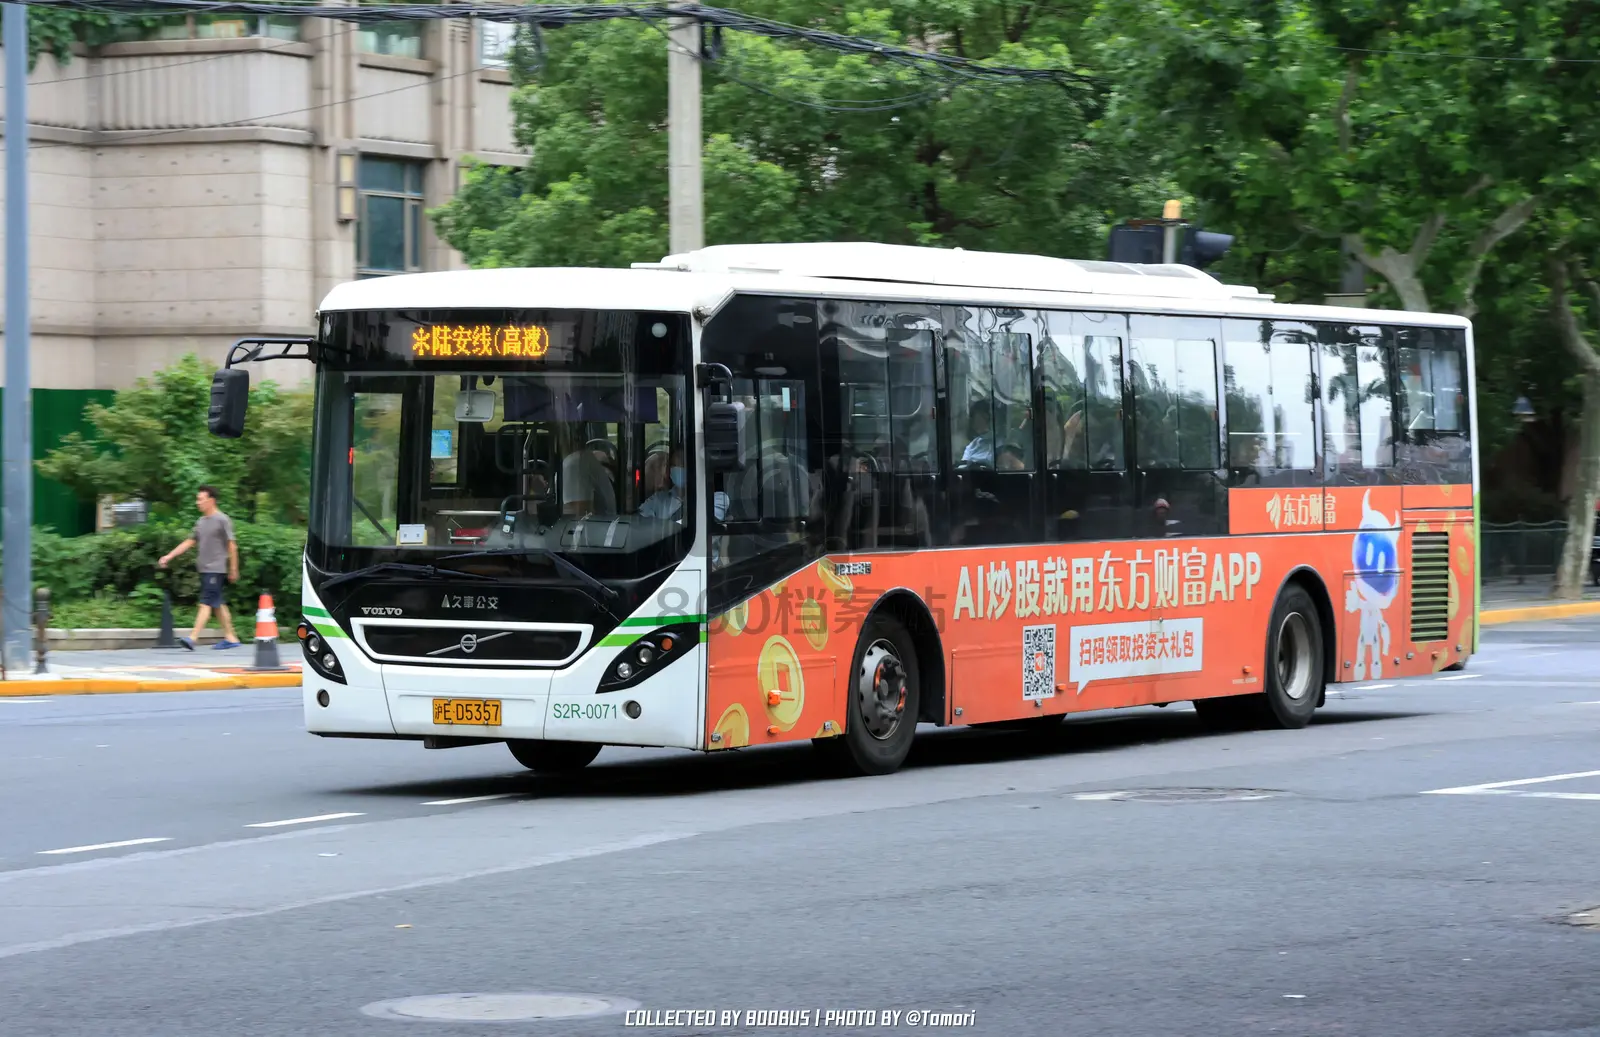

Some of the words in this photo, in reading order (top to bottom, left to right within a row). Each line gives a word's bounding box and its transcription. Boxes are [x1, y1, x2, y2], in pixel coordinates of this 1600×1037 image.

[1283, 493, 1336, 526] 东方财富
[953, 547, 1262, 620] AI炒股就用东方财富APP
[361, 607, 403, 616] VOLVO
[1079, 630, 1195, 667] 扫码领取投资大礼包
[553, 703, 618, 719] S2R-0071
